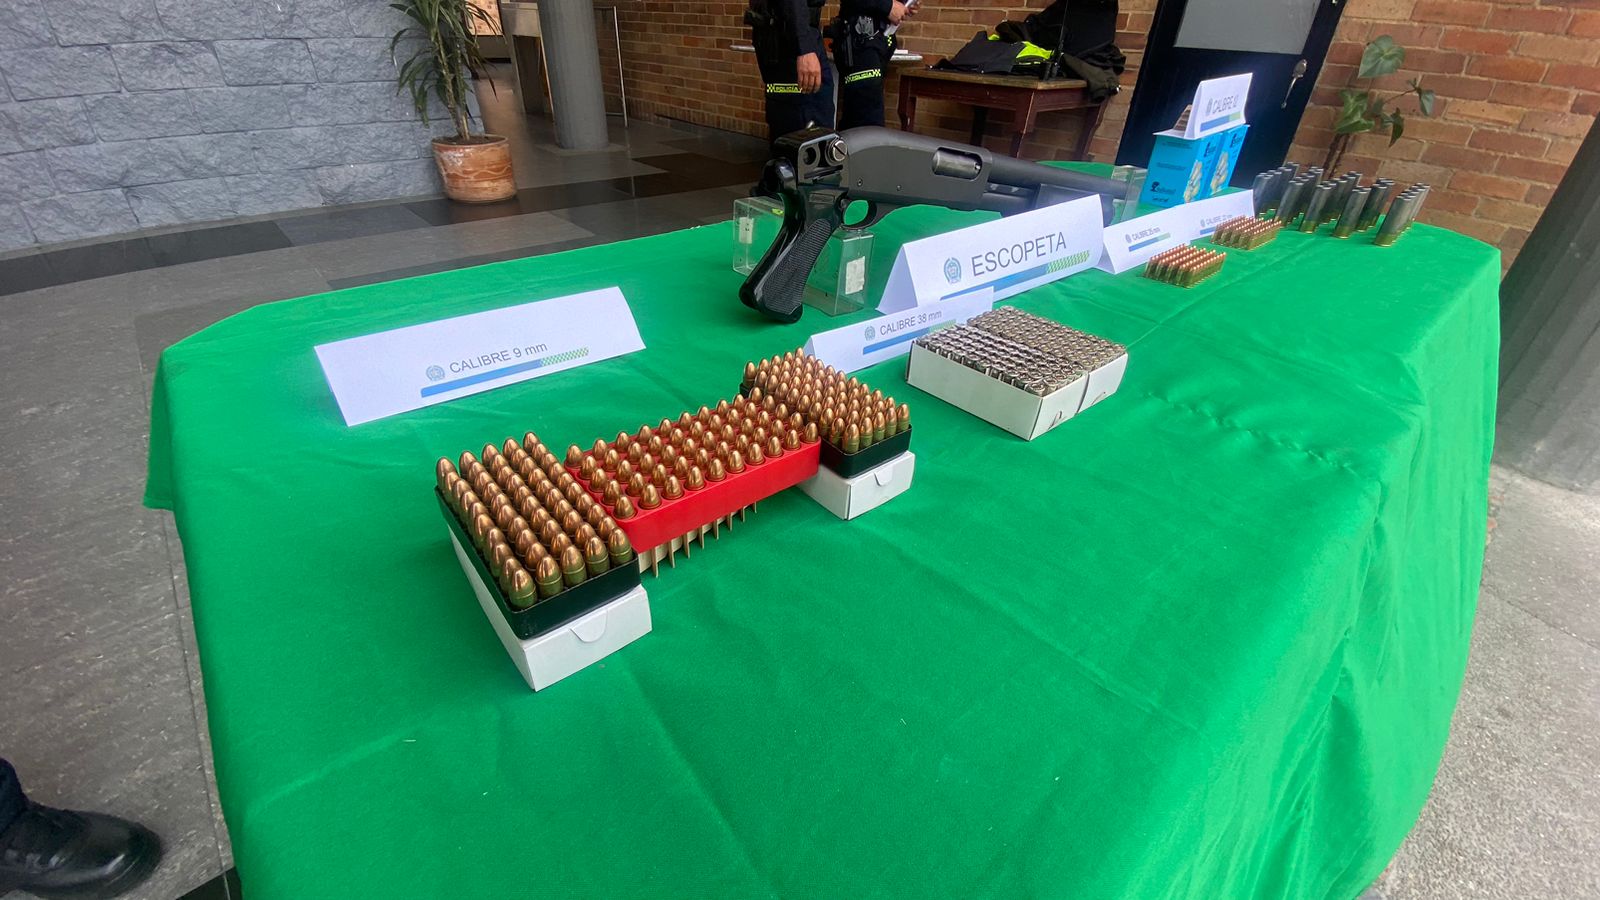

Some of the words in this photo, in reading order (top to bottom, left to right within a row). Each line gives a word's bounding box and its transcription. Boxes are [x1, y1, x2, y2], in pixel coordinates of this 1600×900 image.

[1131, 230, 1149, 241] CALIBRE
[971, 231, 1067, 277] ESCOPETA
[880, 316, 916, 336] CALIBRE
[917, 313, 927, 324] 38
[928, 311, 942, 321] mm
[449, 350, 512, 373] CALIBRE
[512, 347, 522, 358] 9
[525, 343, 548, 355] mm
